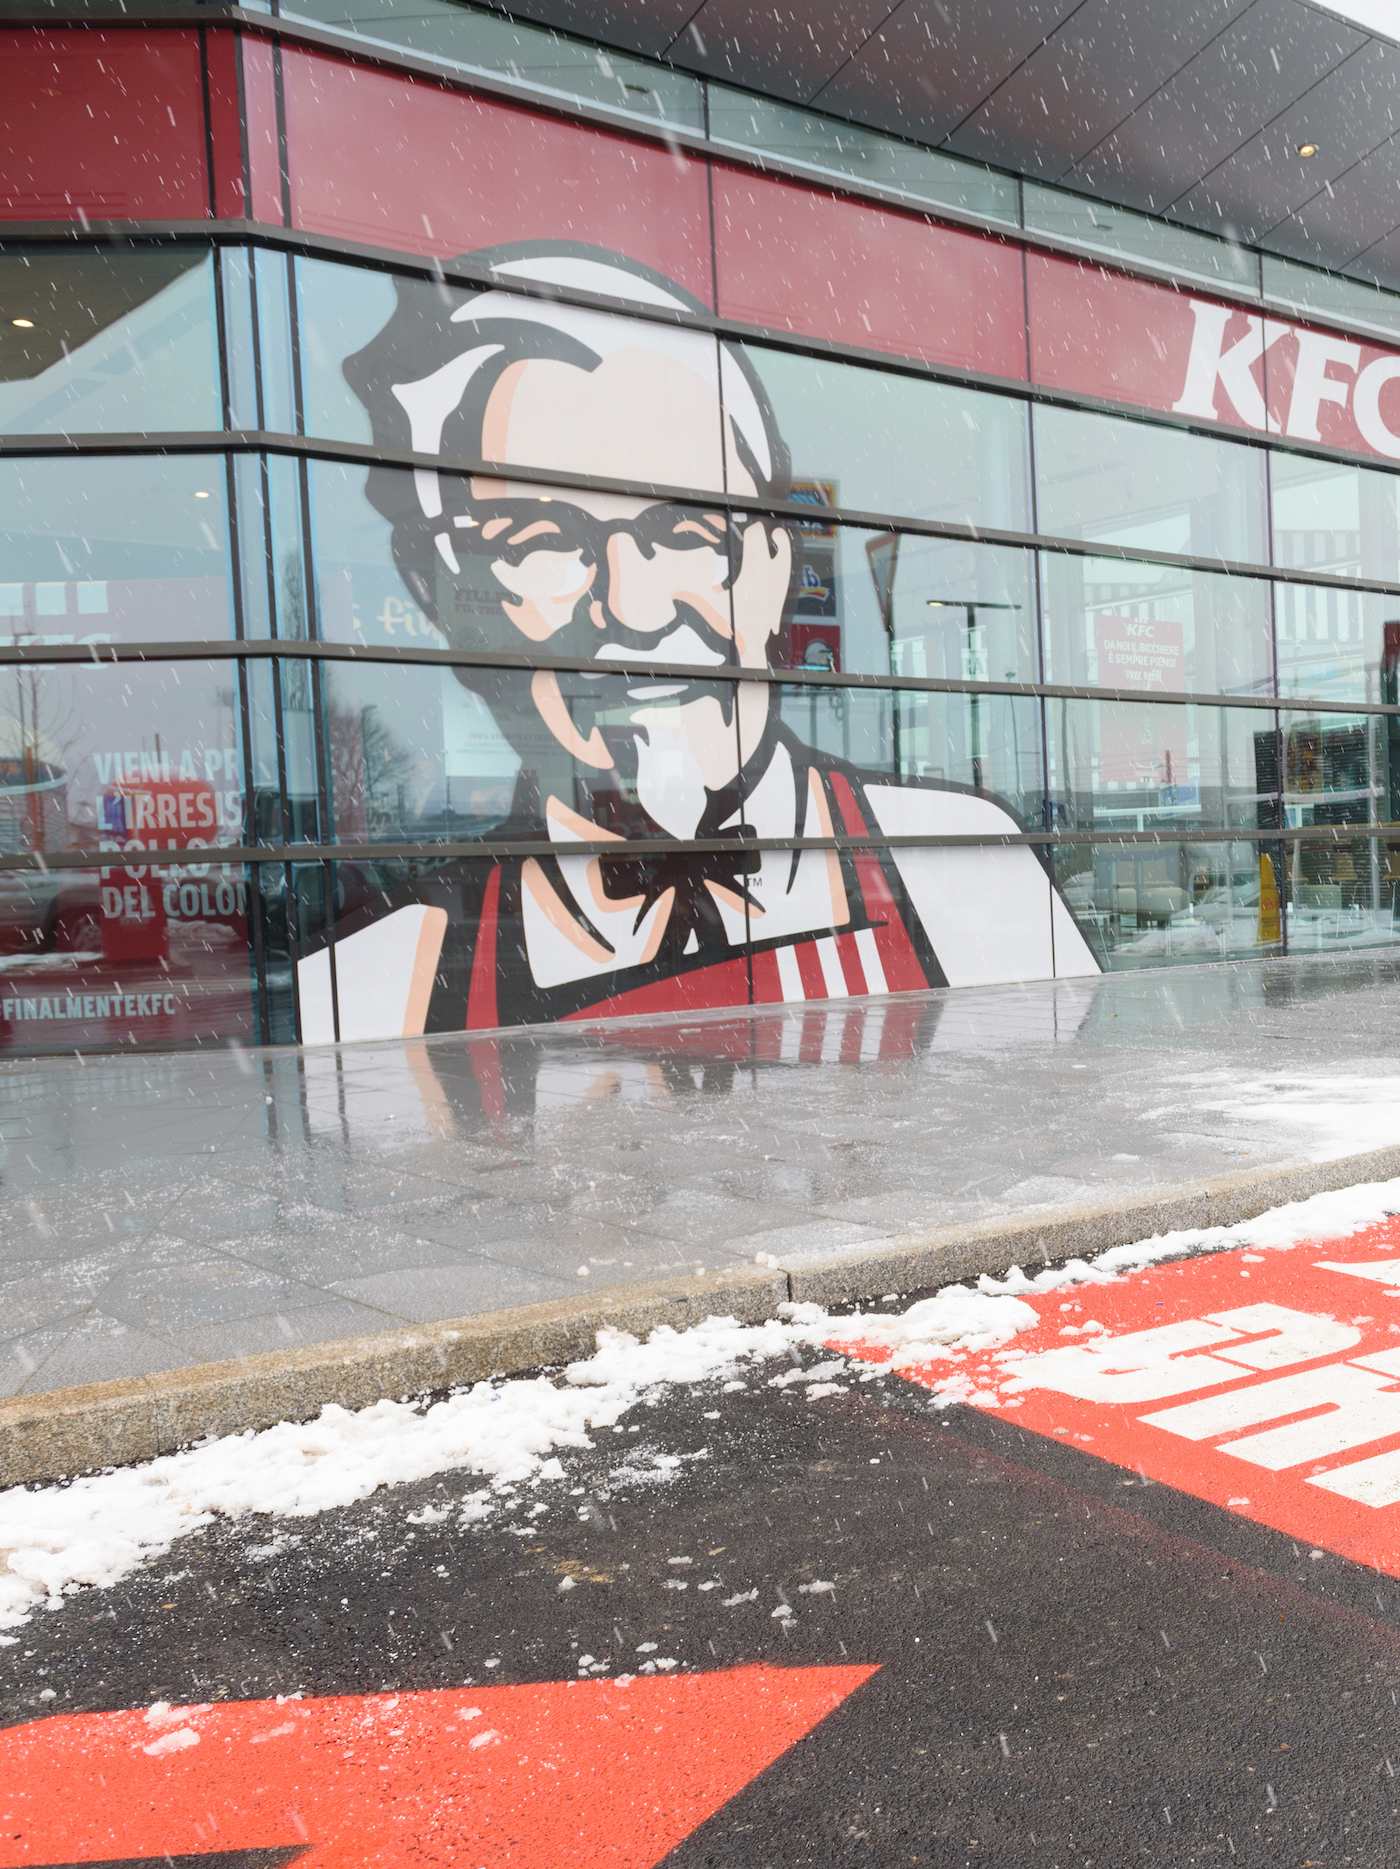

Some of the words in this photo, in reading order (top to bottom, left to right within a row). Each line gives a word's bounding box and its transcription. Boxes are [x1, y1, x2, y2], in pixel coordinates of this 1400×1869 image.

[1126, 624, 1155, 638] KFC
[1103, 639, 1115, 650] DA
[1116, 640, 1131, 652] NOI
[1139, 642, 1180, 656] BICCHIERE
[1115, 653, 1149, 666] SEMPRE
[1149, 656, 1177, 668] PIENO!
[92, 751, 170, 785] VIENI
[178, 749, 197, 783] A
[102, 885, 156, 919] DEL
[0, 993, 176, 1021] FINALMENTEKFC
